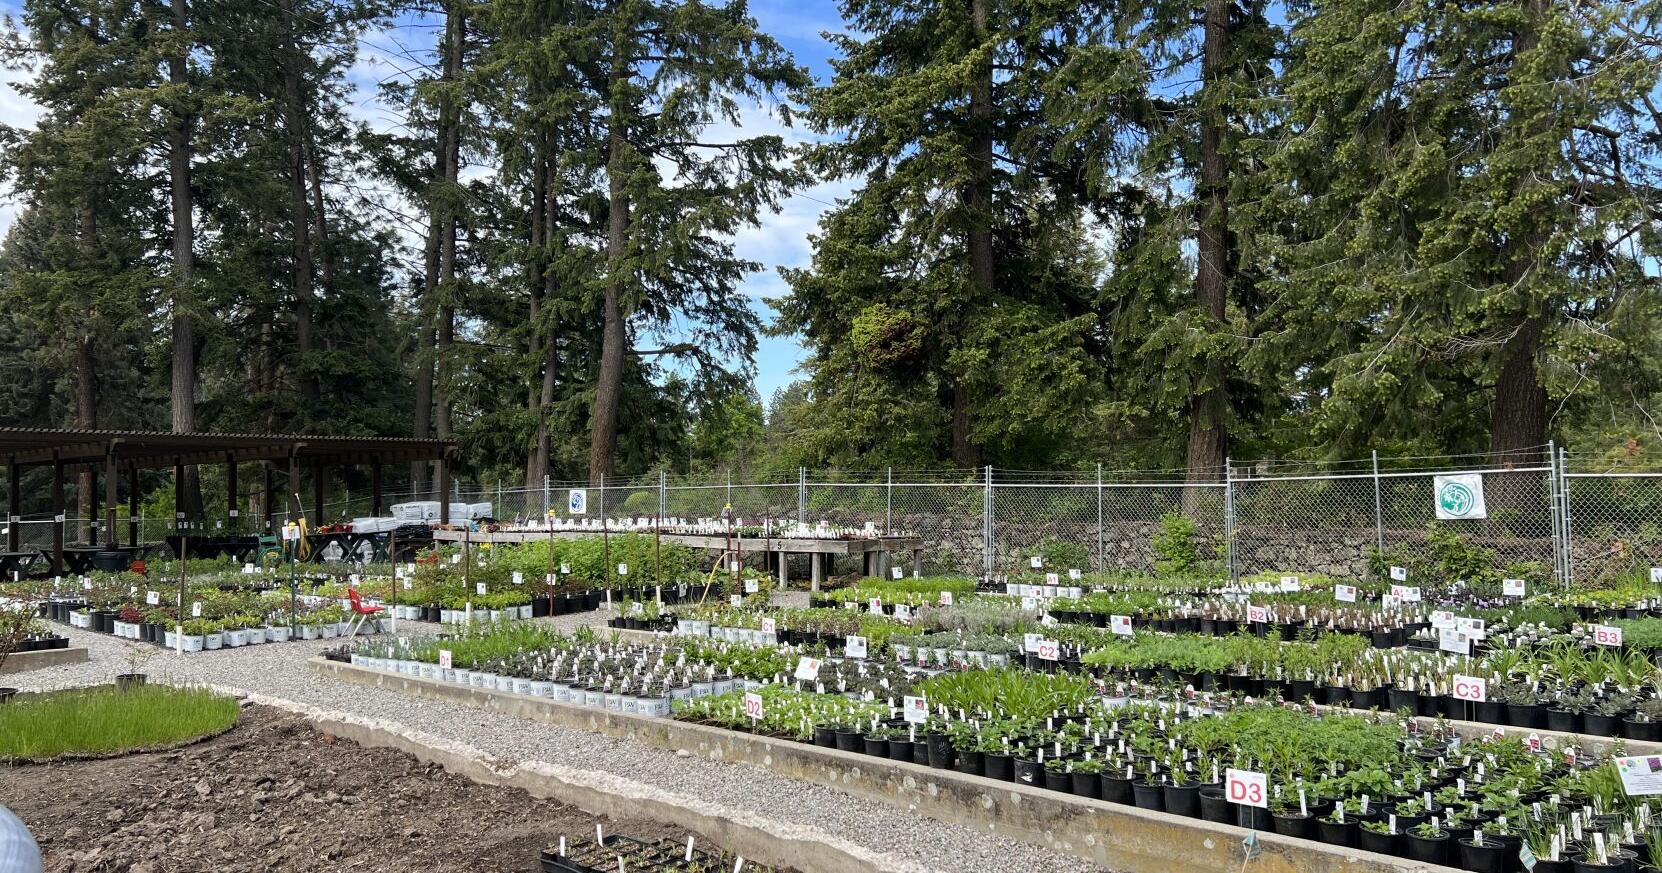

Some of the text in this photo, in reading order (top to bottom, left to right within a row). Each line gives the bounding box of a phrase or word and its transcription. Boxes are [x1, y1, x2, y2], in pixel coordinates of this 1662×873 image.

[777, 540, 782, 550] 5
[1250, 610, 1264, 620] B2
[763, 622, 773, 632] C1
[1597, 631, 1618, 643] B3
[1039, 645, 1055, 658] C2
[440, 655, 450, 666] D1
[1456, 683, 1481, 699] C3
[747, 700, 761, 716] D2
[1231, 780, 1262, 803] D3
